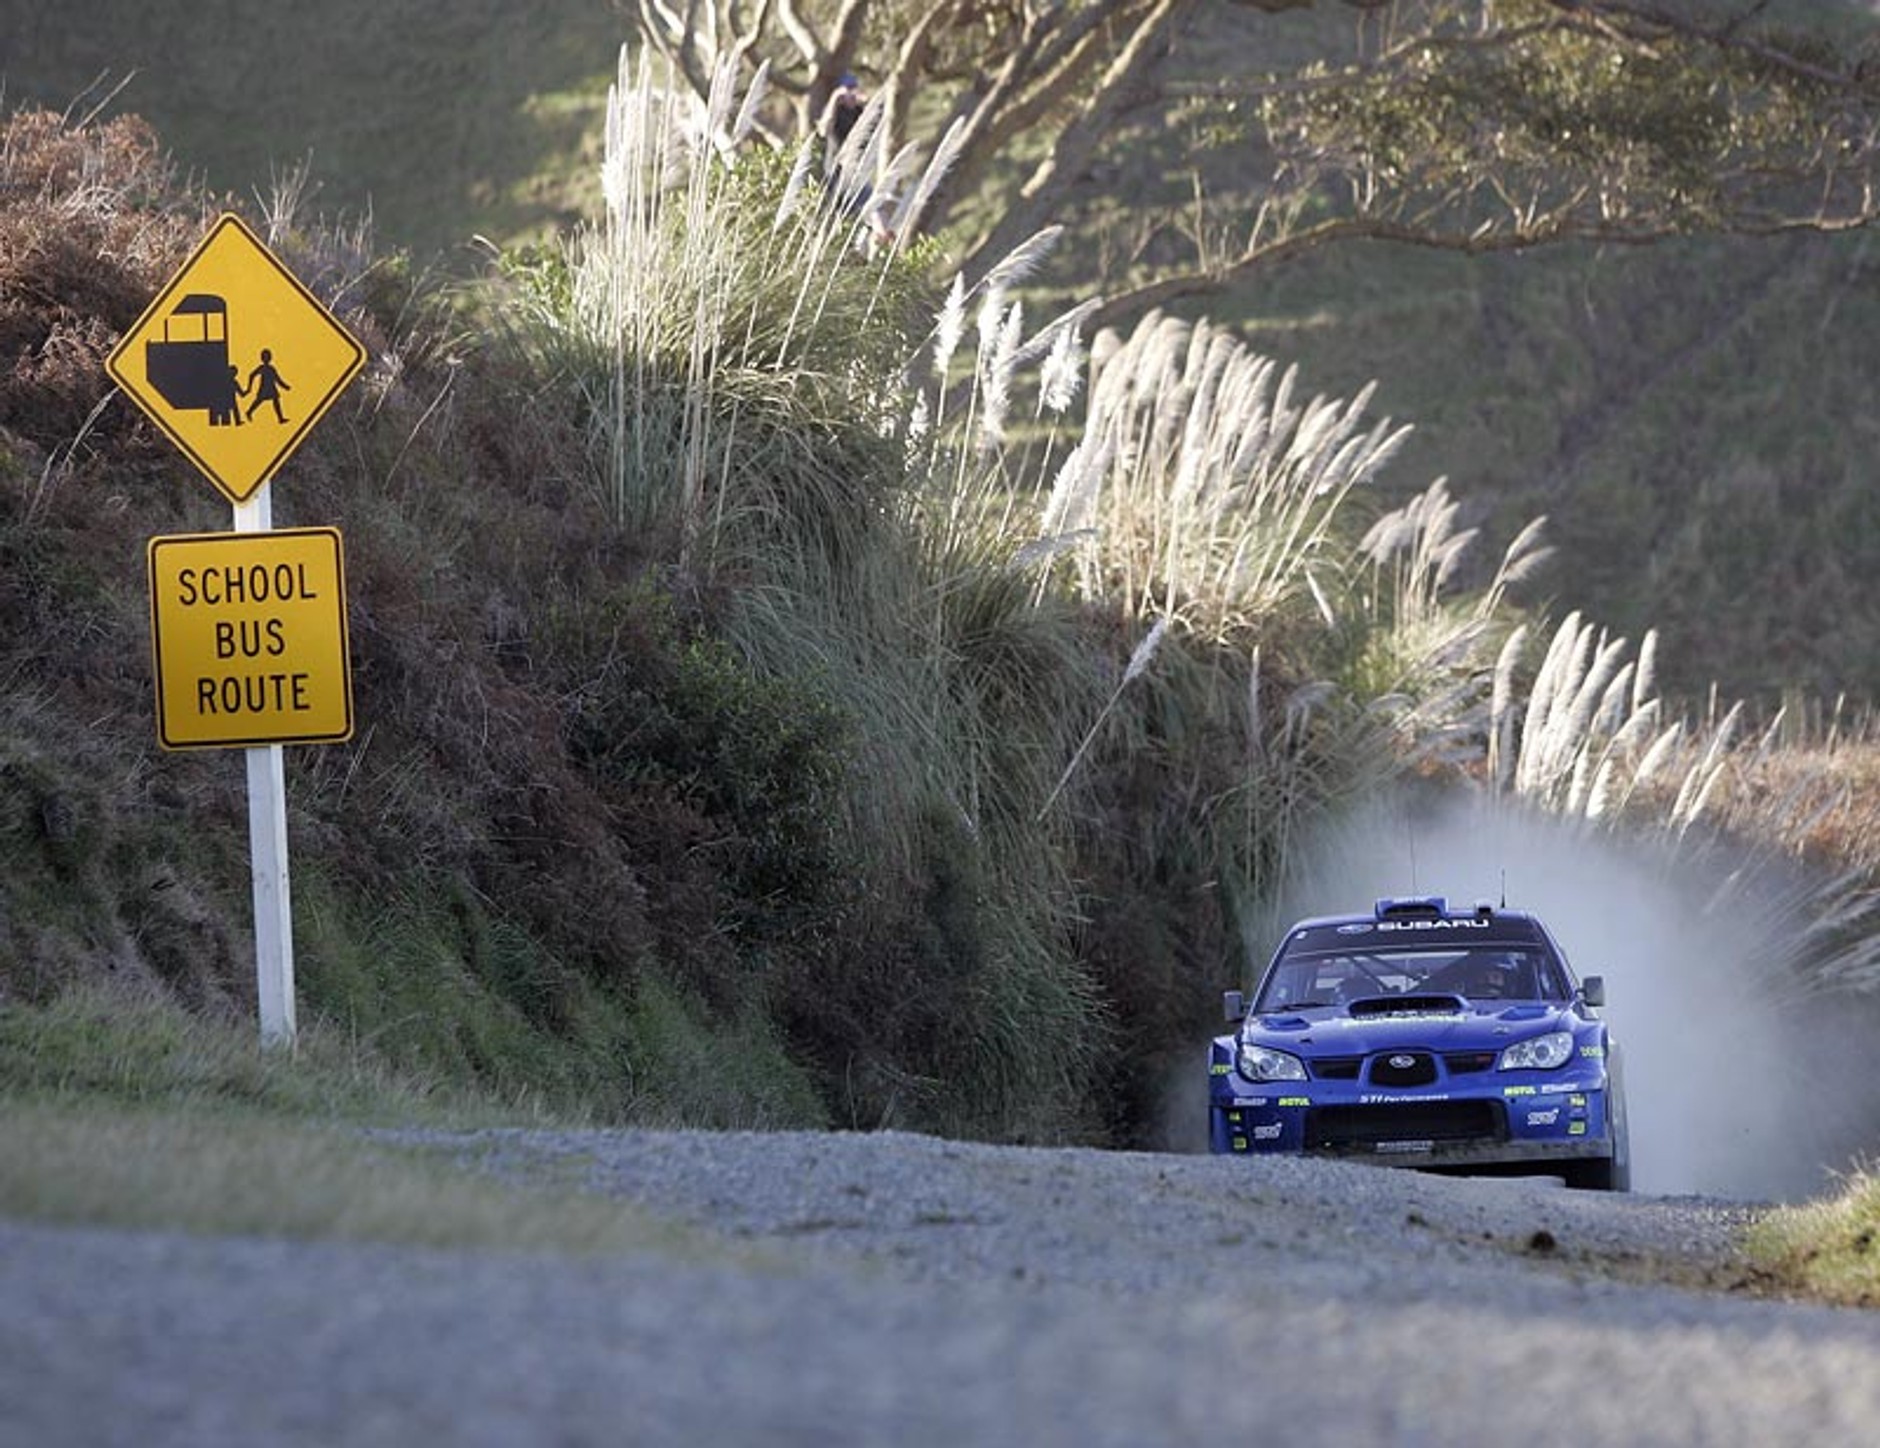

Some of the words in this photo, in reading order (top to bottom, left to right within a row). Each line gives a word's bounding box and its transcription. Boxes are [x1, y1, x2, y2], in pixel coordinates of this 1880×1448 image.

[178, 563, 317, 605] SCHOOL
[216, 618, 286, 659] BUS
[197, 673, 311, 715] ROUTE
[1377, 919, 1489, 931] SUBARU
